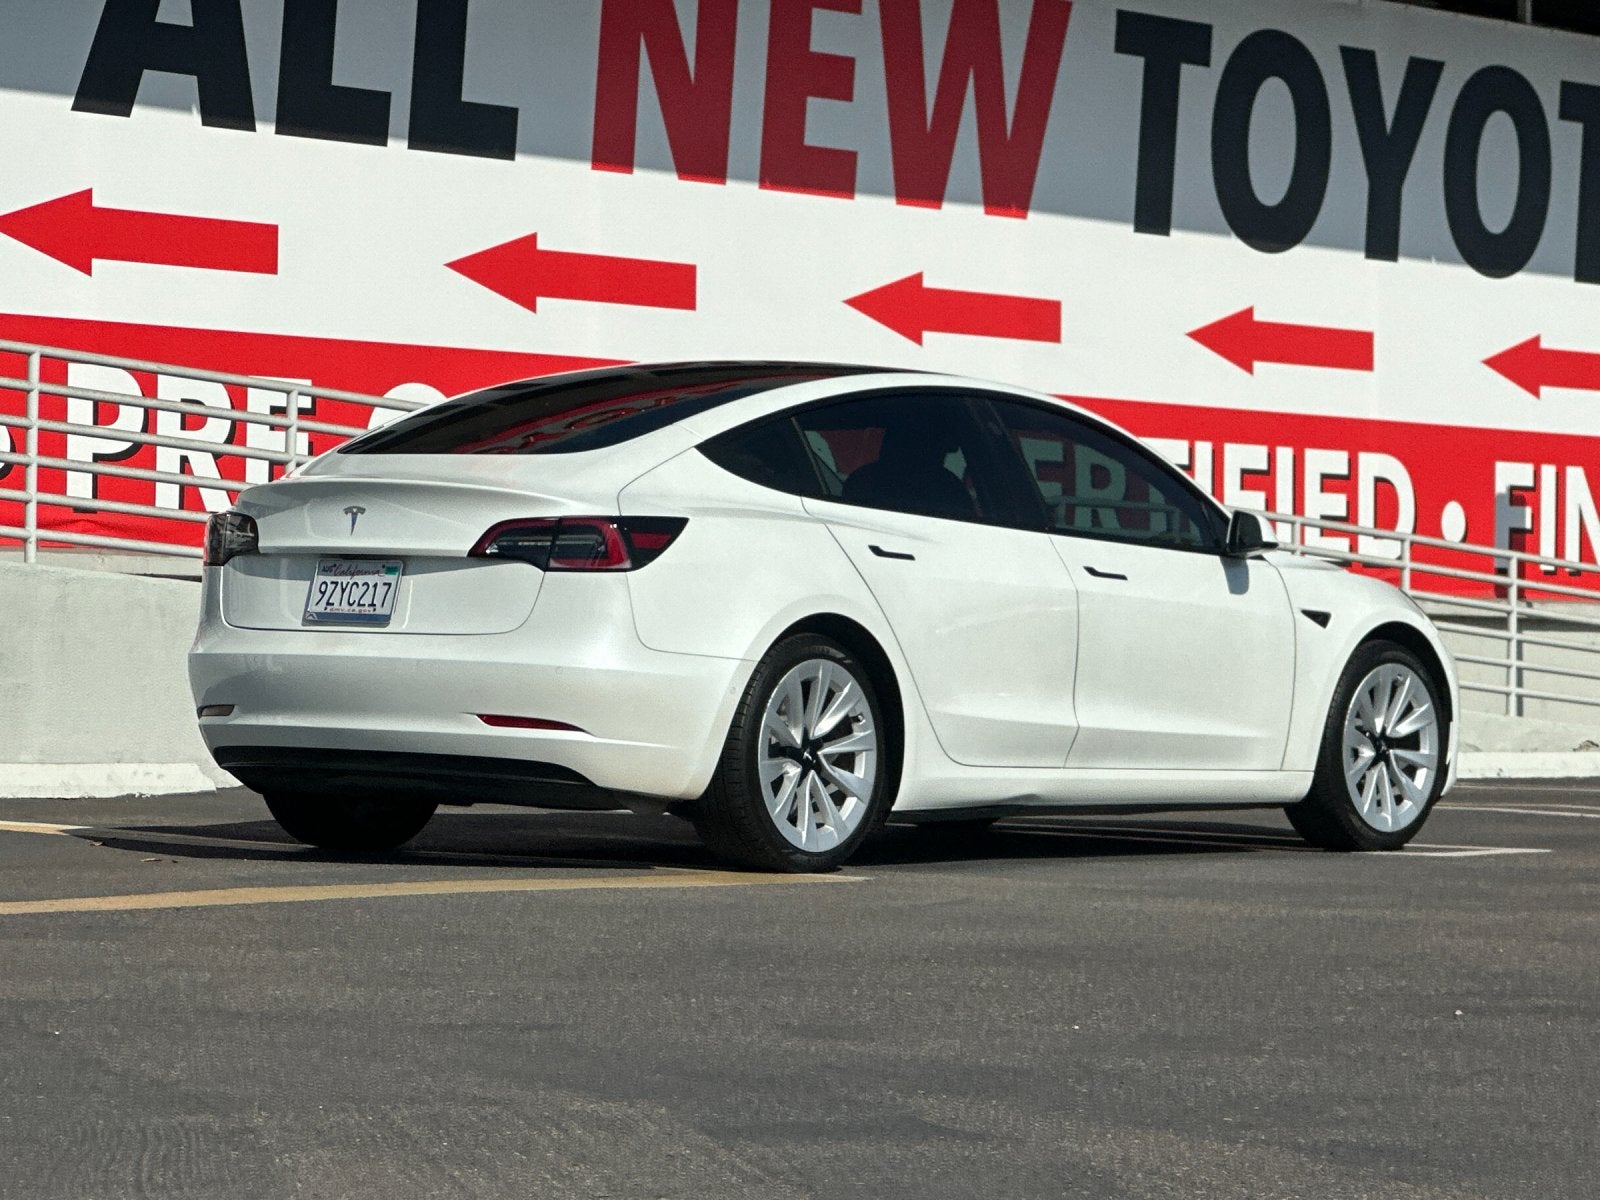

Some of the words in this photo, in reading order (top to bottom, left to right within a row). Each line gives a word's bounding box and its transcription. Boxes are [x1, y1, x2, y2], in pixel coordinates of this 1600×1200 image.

[591, 0, 1073, 220] NEW
[66, 362, 315, 513] PRE
[316, 581, 392, 608] 9ZYC217
[334, 563, 384, 580] California
